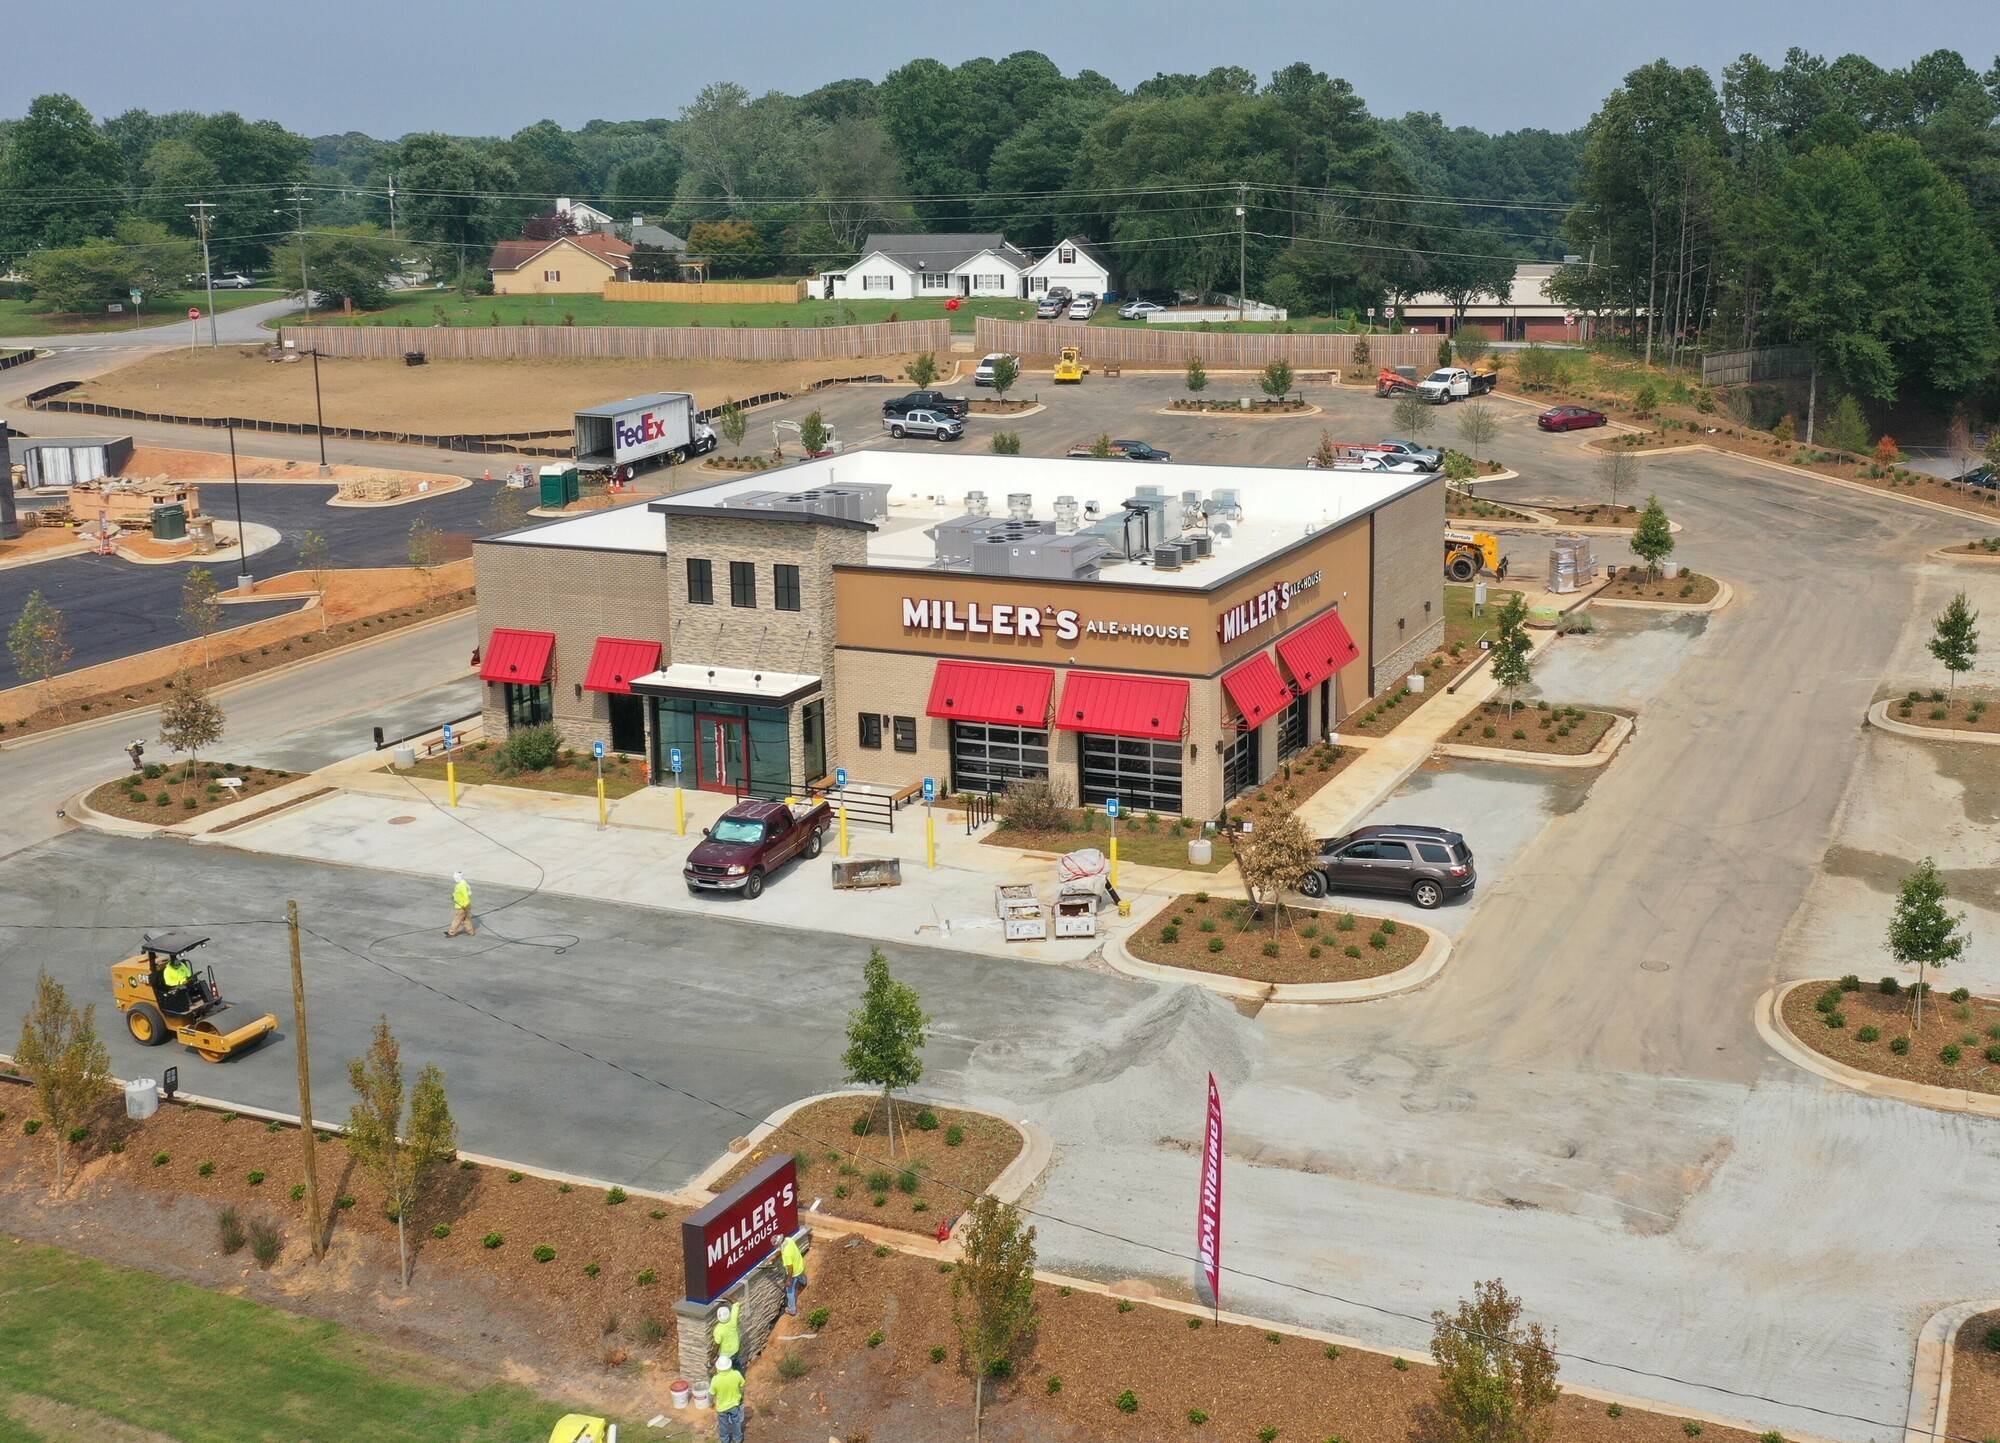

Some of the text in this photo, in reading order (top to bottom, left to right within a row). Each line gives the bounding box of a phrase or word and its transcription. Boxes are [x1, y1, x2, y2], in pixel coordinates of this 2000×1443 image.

[616, 412, 666, 450] FedEx
[901, 597, 1190, 640] MILLER'S ALE HOUSE
[1221, 570, 1323, 643] MILLER'S ALE HOUSE
[707, 1182, 794, 1268] MILLER'S
[726, 1218, 779, 1269] ALE HOUSE
